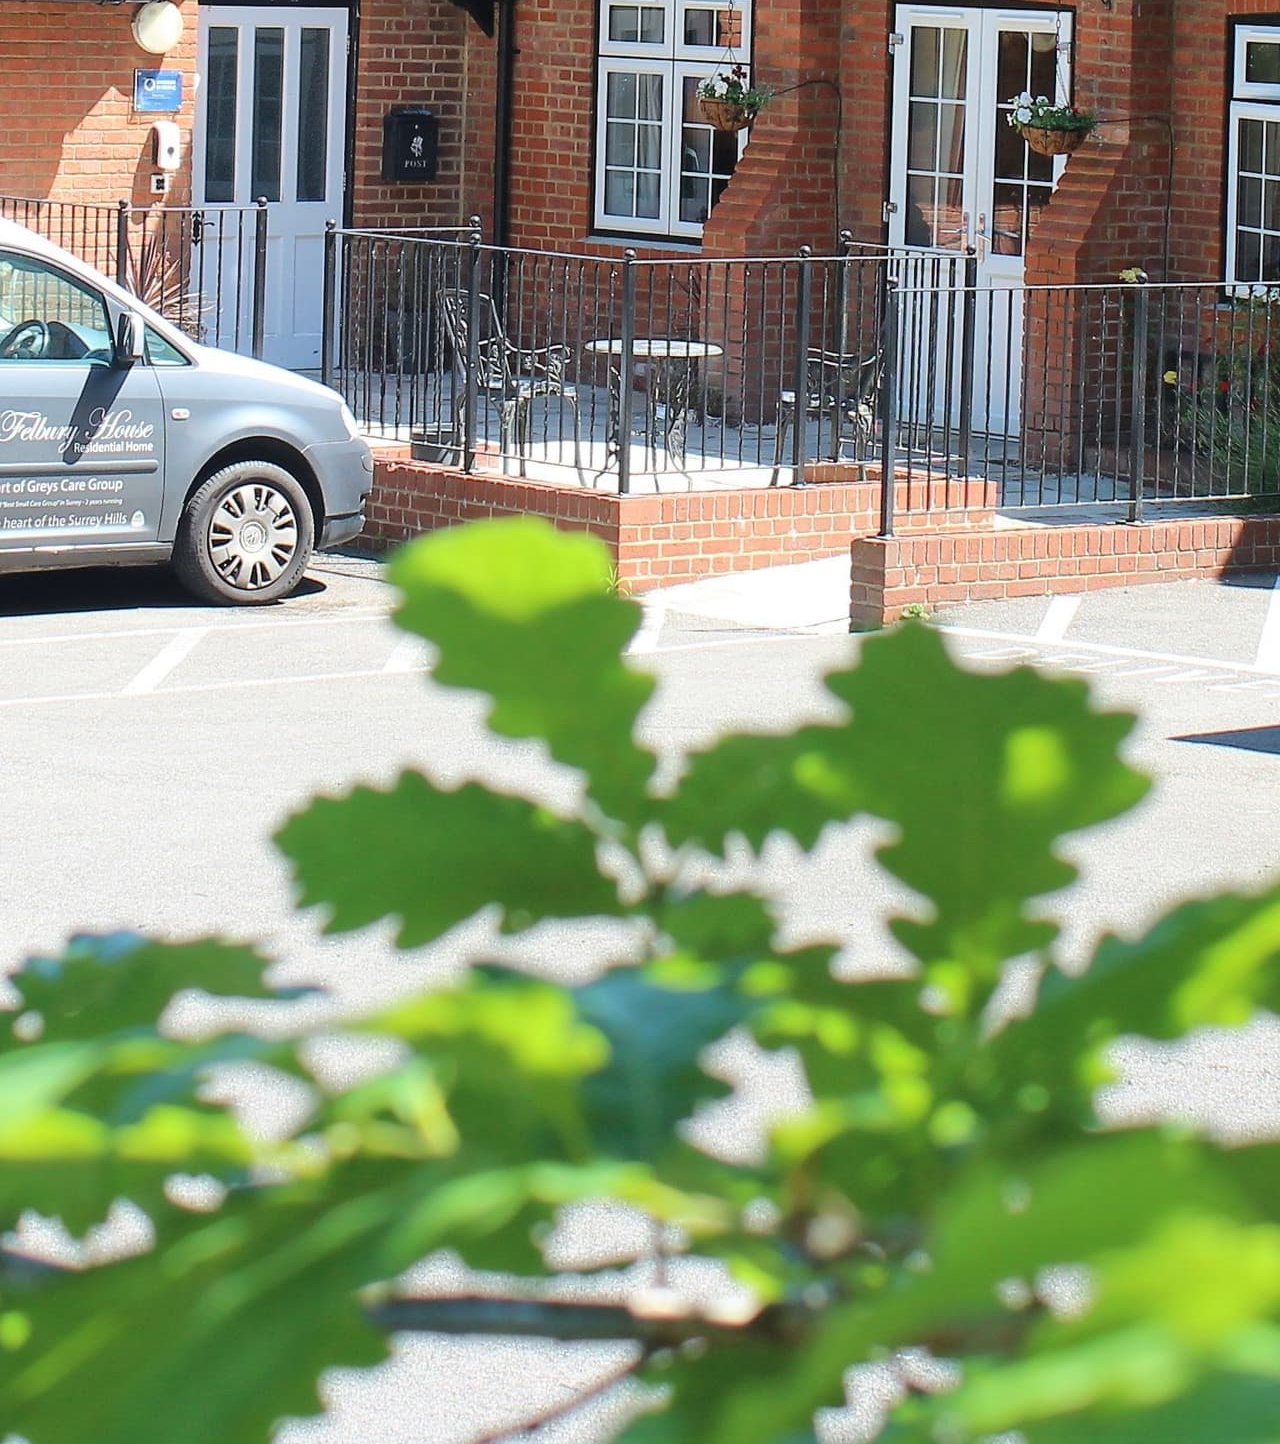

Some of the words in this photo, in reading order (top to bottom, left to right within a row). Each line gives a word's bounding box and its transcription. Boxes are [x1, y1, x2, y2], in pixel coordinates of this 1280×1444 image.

[404, 159, 426, 168] POST
[85, 407, 154, 440] House
[73, 441, 124, 453] Residential
[125, 441, 154, 452] Home
[12, 480, 26, 493] of
[27, 480, 58, 496] Greys
[60, 479, 86, 492] Care
[88, 478, 123, 493] Group
[2, 516, 32, 529] heart
[34, 514, 48, 528] of
[47, 514, 66, 527] the
[68, 513, 104, 530] Surrey
[104, 512, 128, 525] Hills
